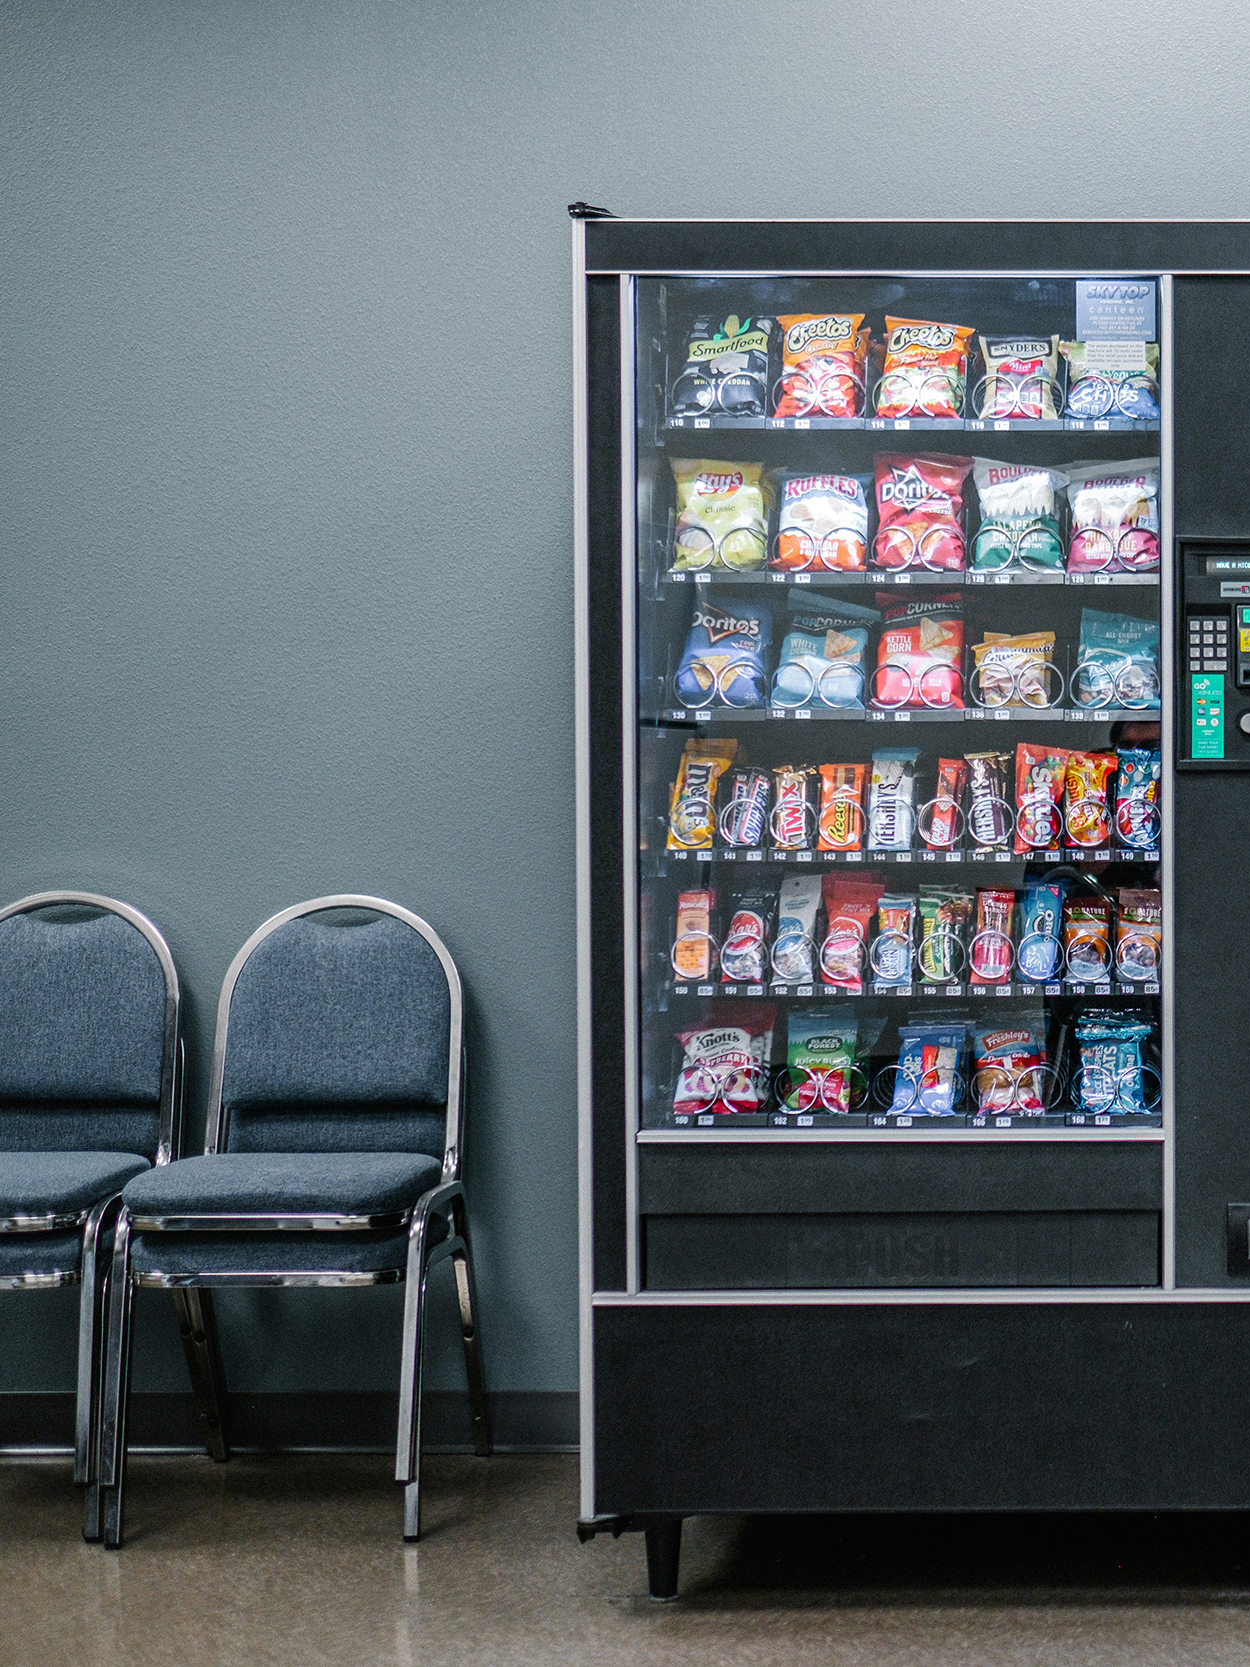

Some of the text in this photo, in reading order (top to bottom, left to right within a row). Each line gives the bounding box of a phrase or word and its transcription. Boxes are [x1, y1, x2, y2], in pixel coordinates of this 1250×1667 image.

[1089, 306, 1144, 314] canteen
[789, 317, 852, 353] Cheetos
[888, 326, 956, 353] Cheetos
[692, 336, 764, 357] Smartfood
[786, 476, 858, 499] RUFFLES
[882, 483, 951, 502] Doritos
[791, 639, 818, 650] WHITE
[886, 643, 911, 652] CORN
[782, 782, 803, 841] TWIX
[697, 1032, 740, 1049] Knott's
[986, 1031, 1029, 1047] Freshley's
